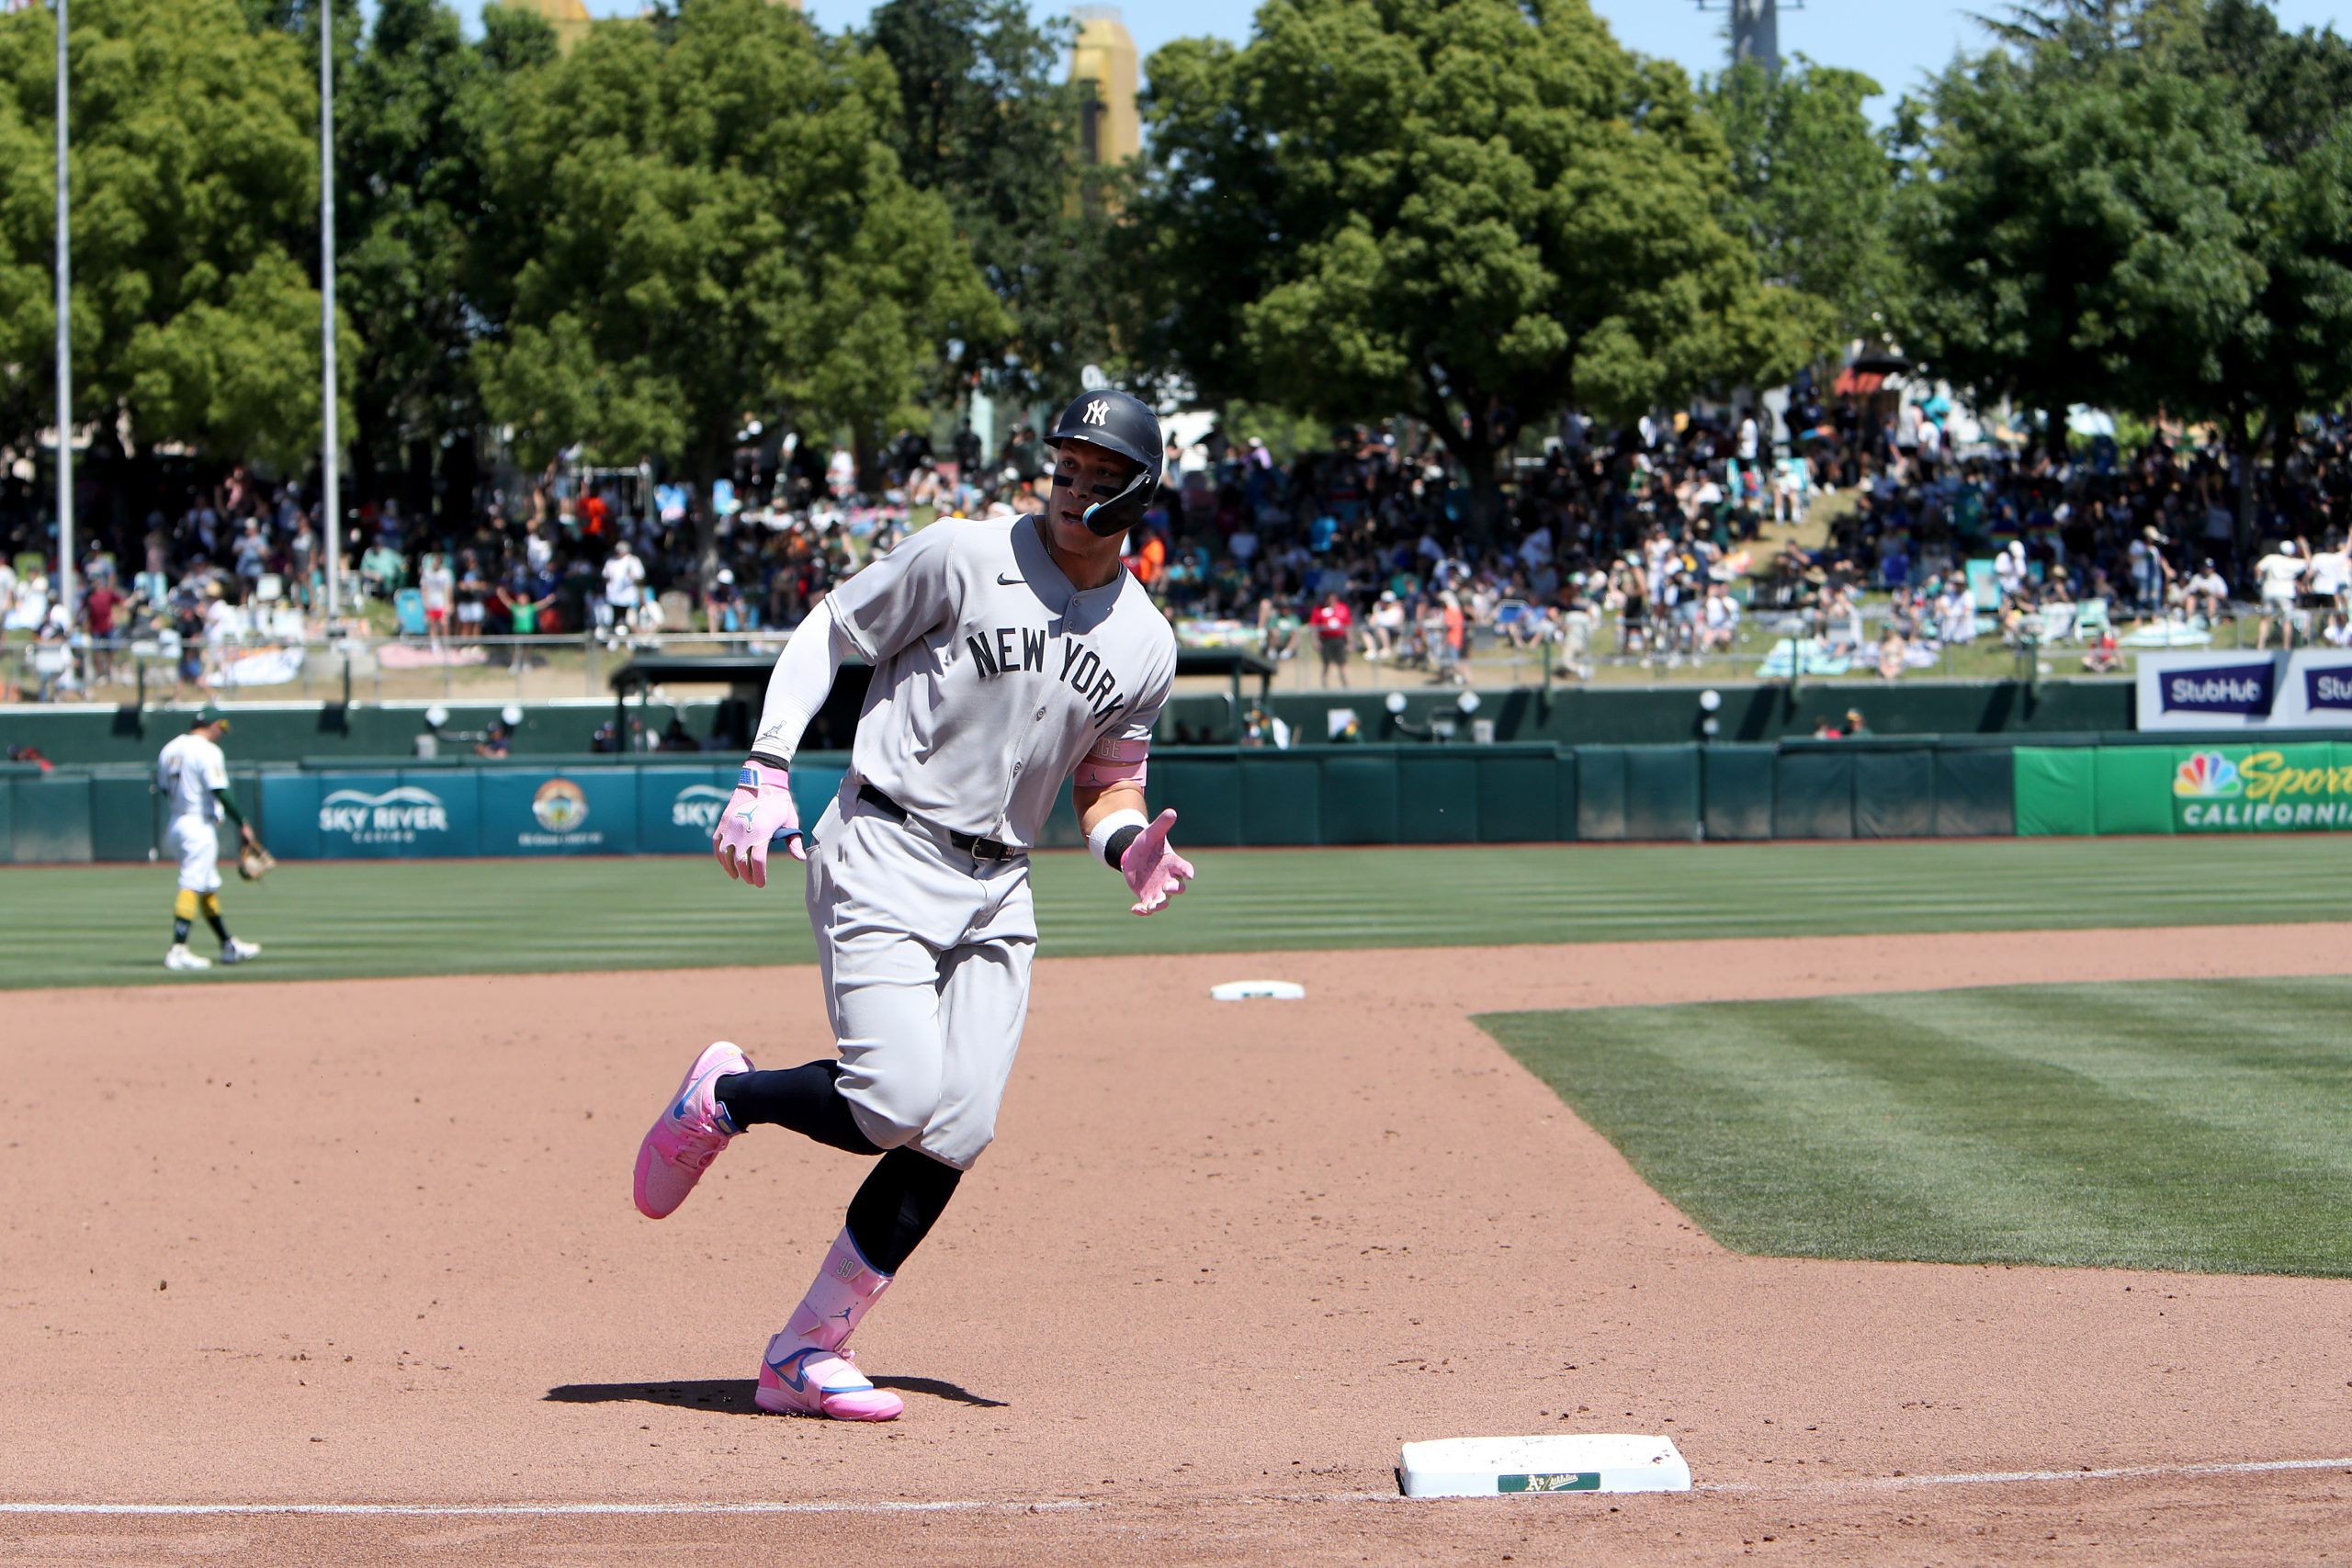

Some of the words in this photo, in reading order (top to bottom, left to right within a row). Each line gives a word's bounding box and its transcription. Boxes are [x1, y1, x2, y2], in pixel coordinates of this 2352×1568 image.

[1082, 399, 1111, 427] NY
[967, 626, 1046, 679] NEW
[1058, 637, 1125, 729] YORK
[2171, 677, 2263, 704] StubHub
[2317, 675, 2352, 701] Stu
[319, 806, 369, 832] SKY
[373, 806, 449, 832] RIVER
[673, 802, 722, 827] SKY
[836, 1257, 854, 1279] 99
